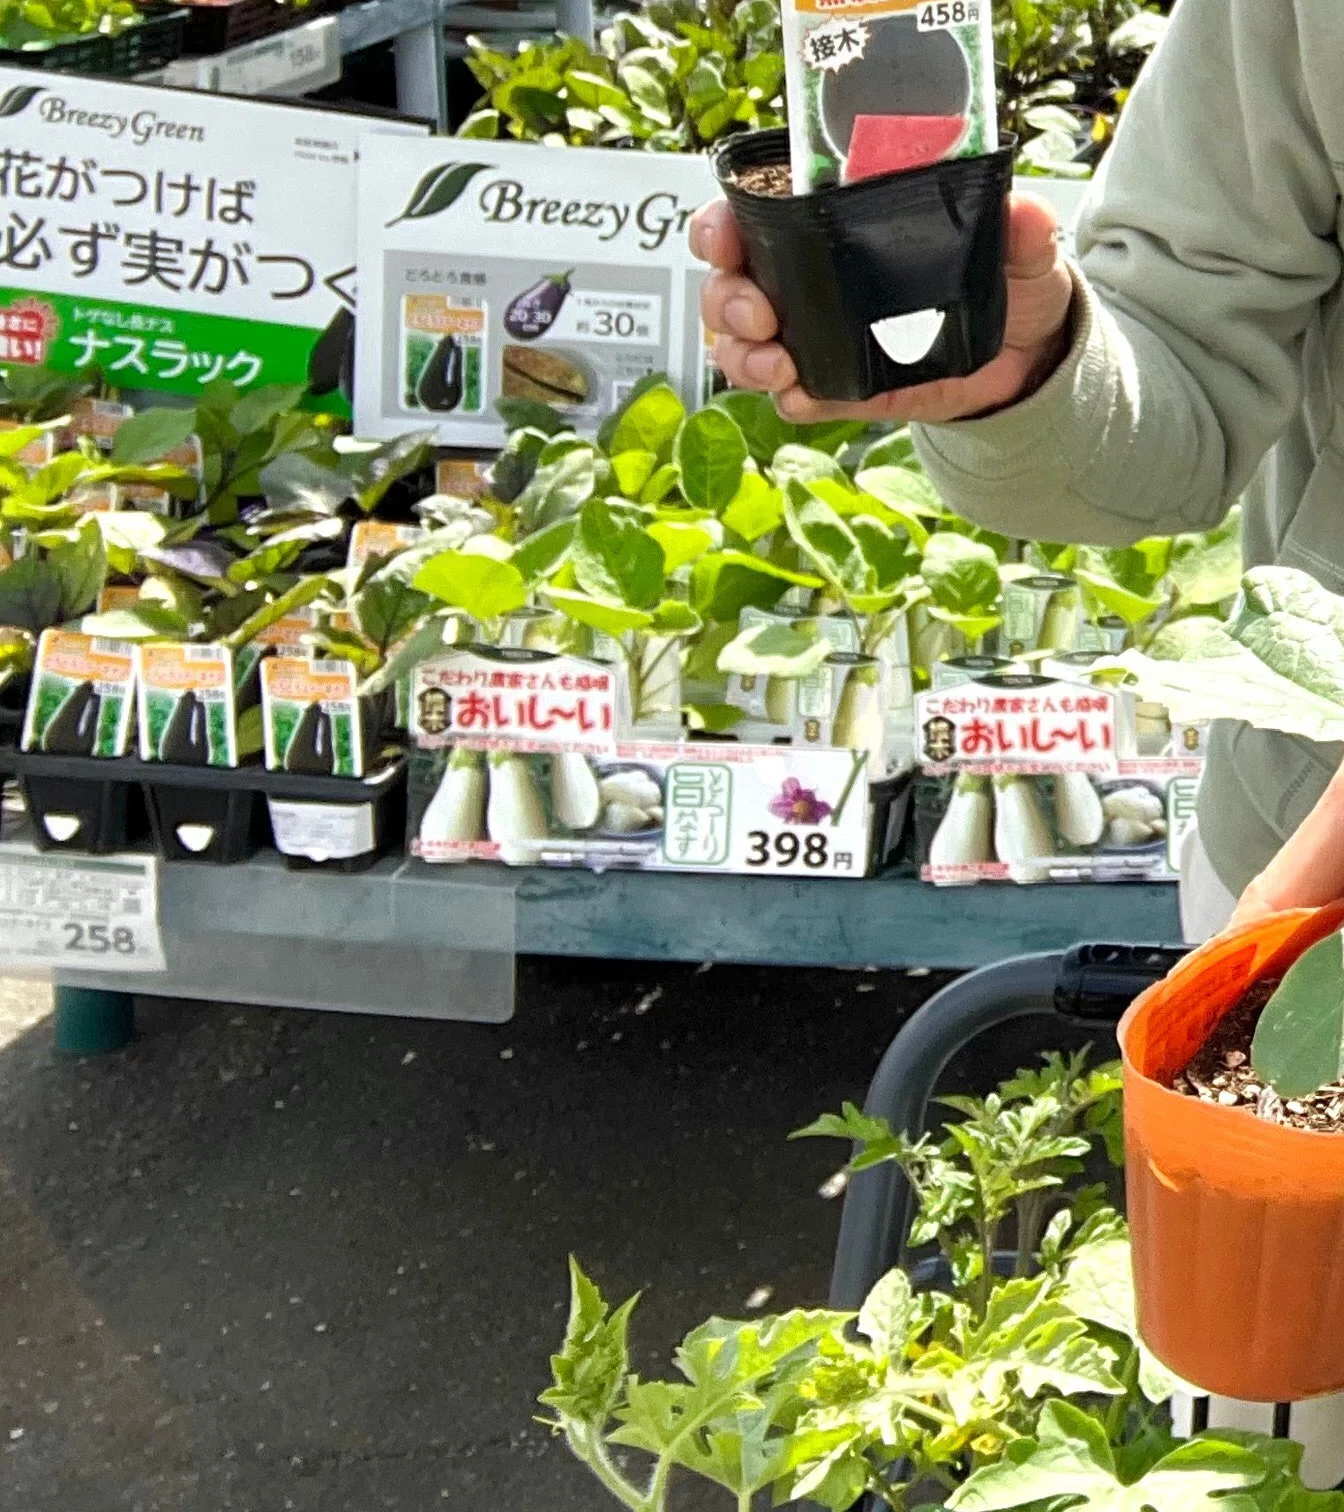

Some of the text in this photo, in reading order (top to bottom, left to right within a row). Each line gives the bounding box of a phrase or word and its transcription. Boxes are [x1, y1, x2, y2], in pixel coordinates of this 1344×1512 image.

[809, 27, 860, 63] 接木
[39, 96, 205, 146] Breezy Green
[0, 147, 256, 225] 花がつけば
[479, 179, 629, 241] Breezy
[0, 211, 356, 308] 必ず実がつく
[68, 329, 264, 387] ナスラック
[63, 921, 137, 954] 258
